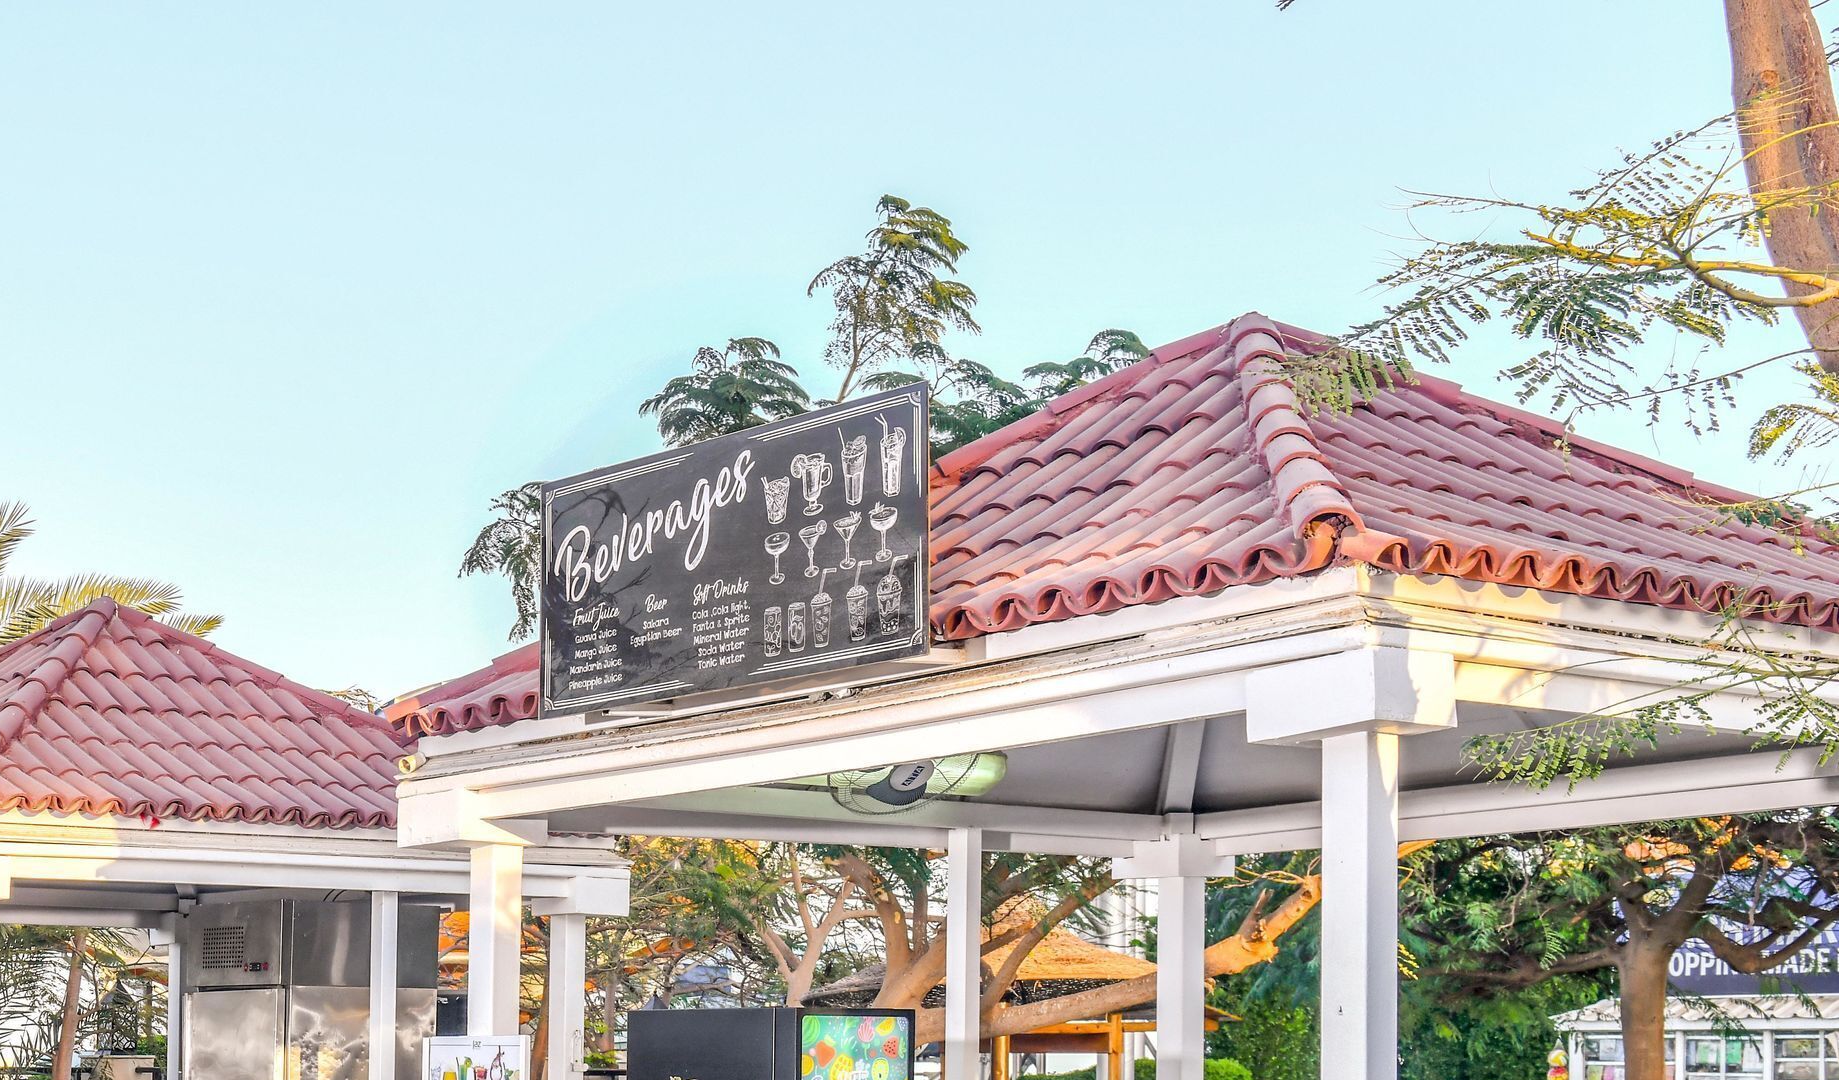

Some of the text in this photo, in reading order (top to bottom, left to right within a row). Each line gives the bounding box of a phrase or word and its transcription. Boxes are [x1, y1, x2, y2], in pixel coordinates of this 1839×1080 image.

[554, 449, 756, 602] Beverages
[693, 576, 750, 606] Soft Drinks
[645, 594, 668, 613] Beer
[572, 601, 620, 631] Fruit Juice
[642, 617, 670, 630] Sakara
[692, 609, 709, 620] Cola
[692, 614, 750, 633] Fanta & Sprite
[574, 628, 618, 644] Guava Juice
[630, 627, 683, 648] Egyptian Beer
[693, 626, 750, 646] Mineral Water
[574, 643, 618, 660] Mango Juice
[697, 640, 745, 657] Soda Water
[569, 657, 623, 675] Mandarin Juice
[697, 653, 746, 670] Tonic Water
[568, 673, 623, 691] Pineapple Juice
